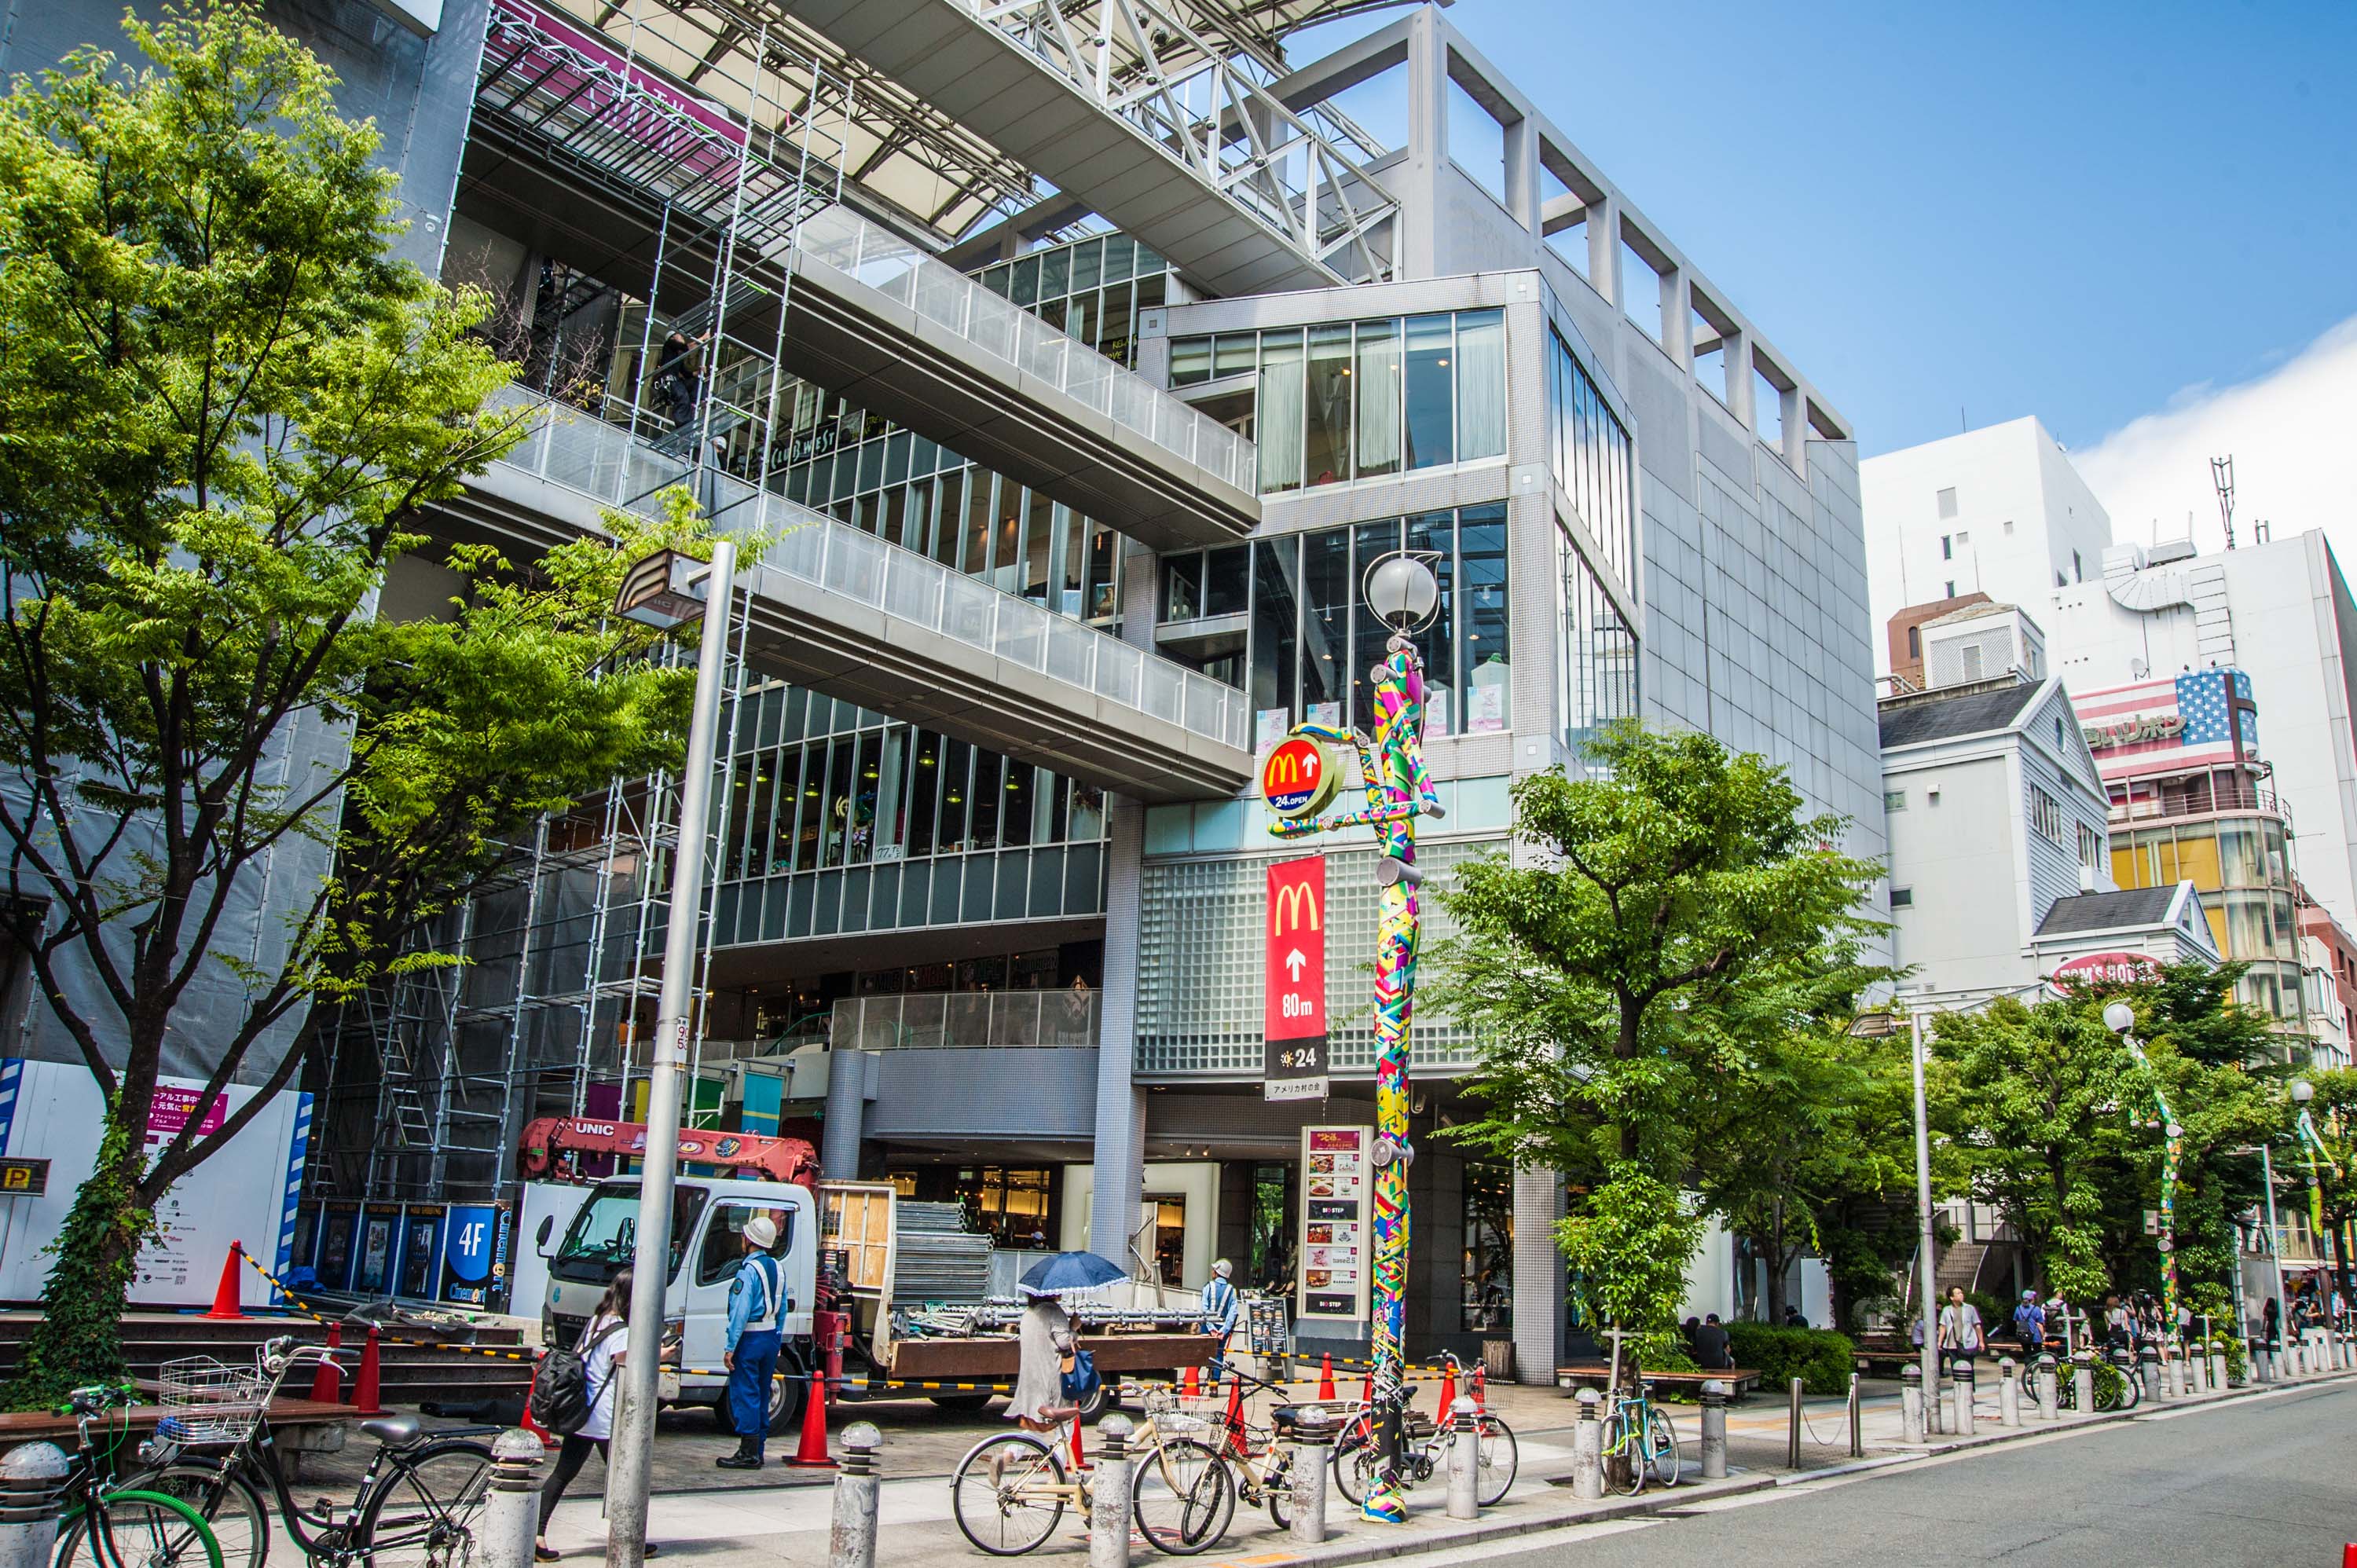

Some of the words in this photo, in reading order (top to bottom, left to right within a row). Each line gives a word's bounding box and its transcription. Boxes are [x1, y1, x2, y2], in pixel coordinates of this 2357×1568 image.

[1290, 796, 1308, 805] OPEN
[1282, 993, 1313, 1018] 80m
[1295, 1048, 1317, 1068] 24
[1274, 1083, 1320, 1094] アメリカ村の会
[575, 1122, 614, 1137] UNIC
[9, 1169, 27, 1185] P
[458, 1222, 486, 1257] 4F
